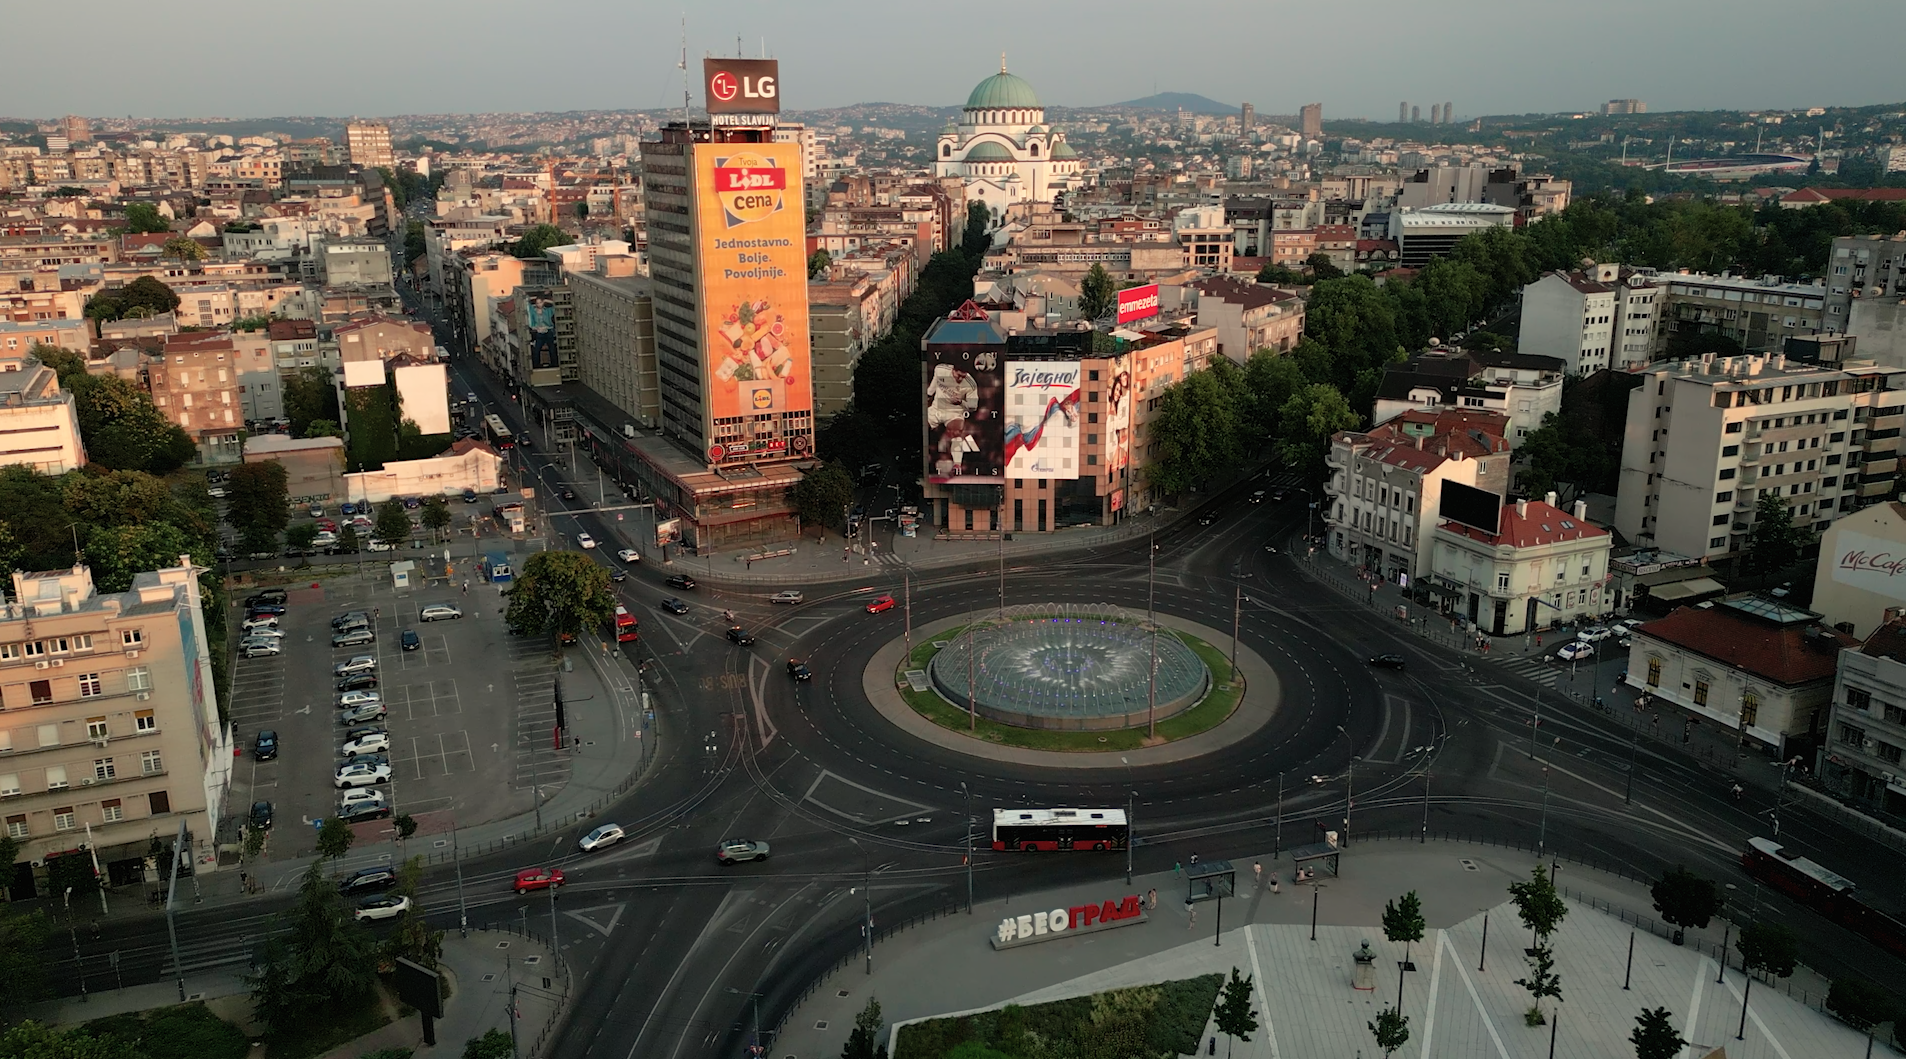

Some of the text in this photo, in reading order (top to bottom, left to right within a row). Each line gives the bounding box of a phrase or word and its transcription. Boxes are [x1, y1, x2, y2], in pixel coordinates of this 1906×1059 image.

[743, 76, 776, 98] LG
[712, 115, 775, 126] HOTEL SLAVIJA
[738, 157, 758, 168] Tvoja
[733, 195, 773, 211] cena
[714, 238, 793, 250] Jednostavno.
[738, 252, 772, 265] Bolje.
[724, 266, 787, 280] Povoljnije.
[1119, 293, 1158, 315] emmezeta
[1009, 368, 1079, 391] Заједно!
[997, 895, 1141, 942] #БЕОГРАД
